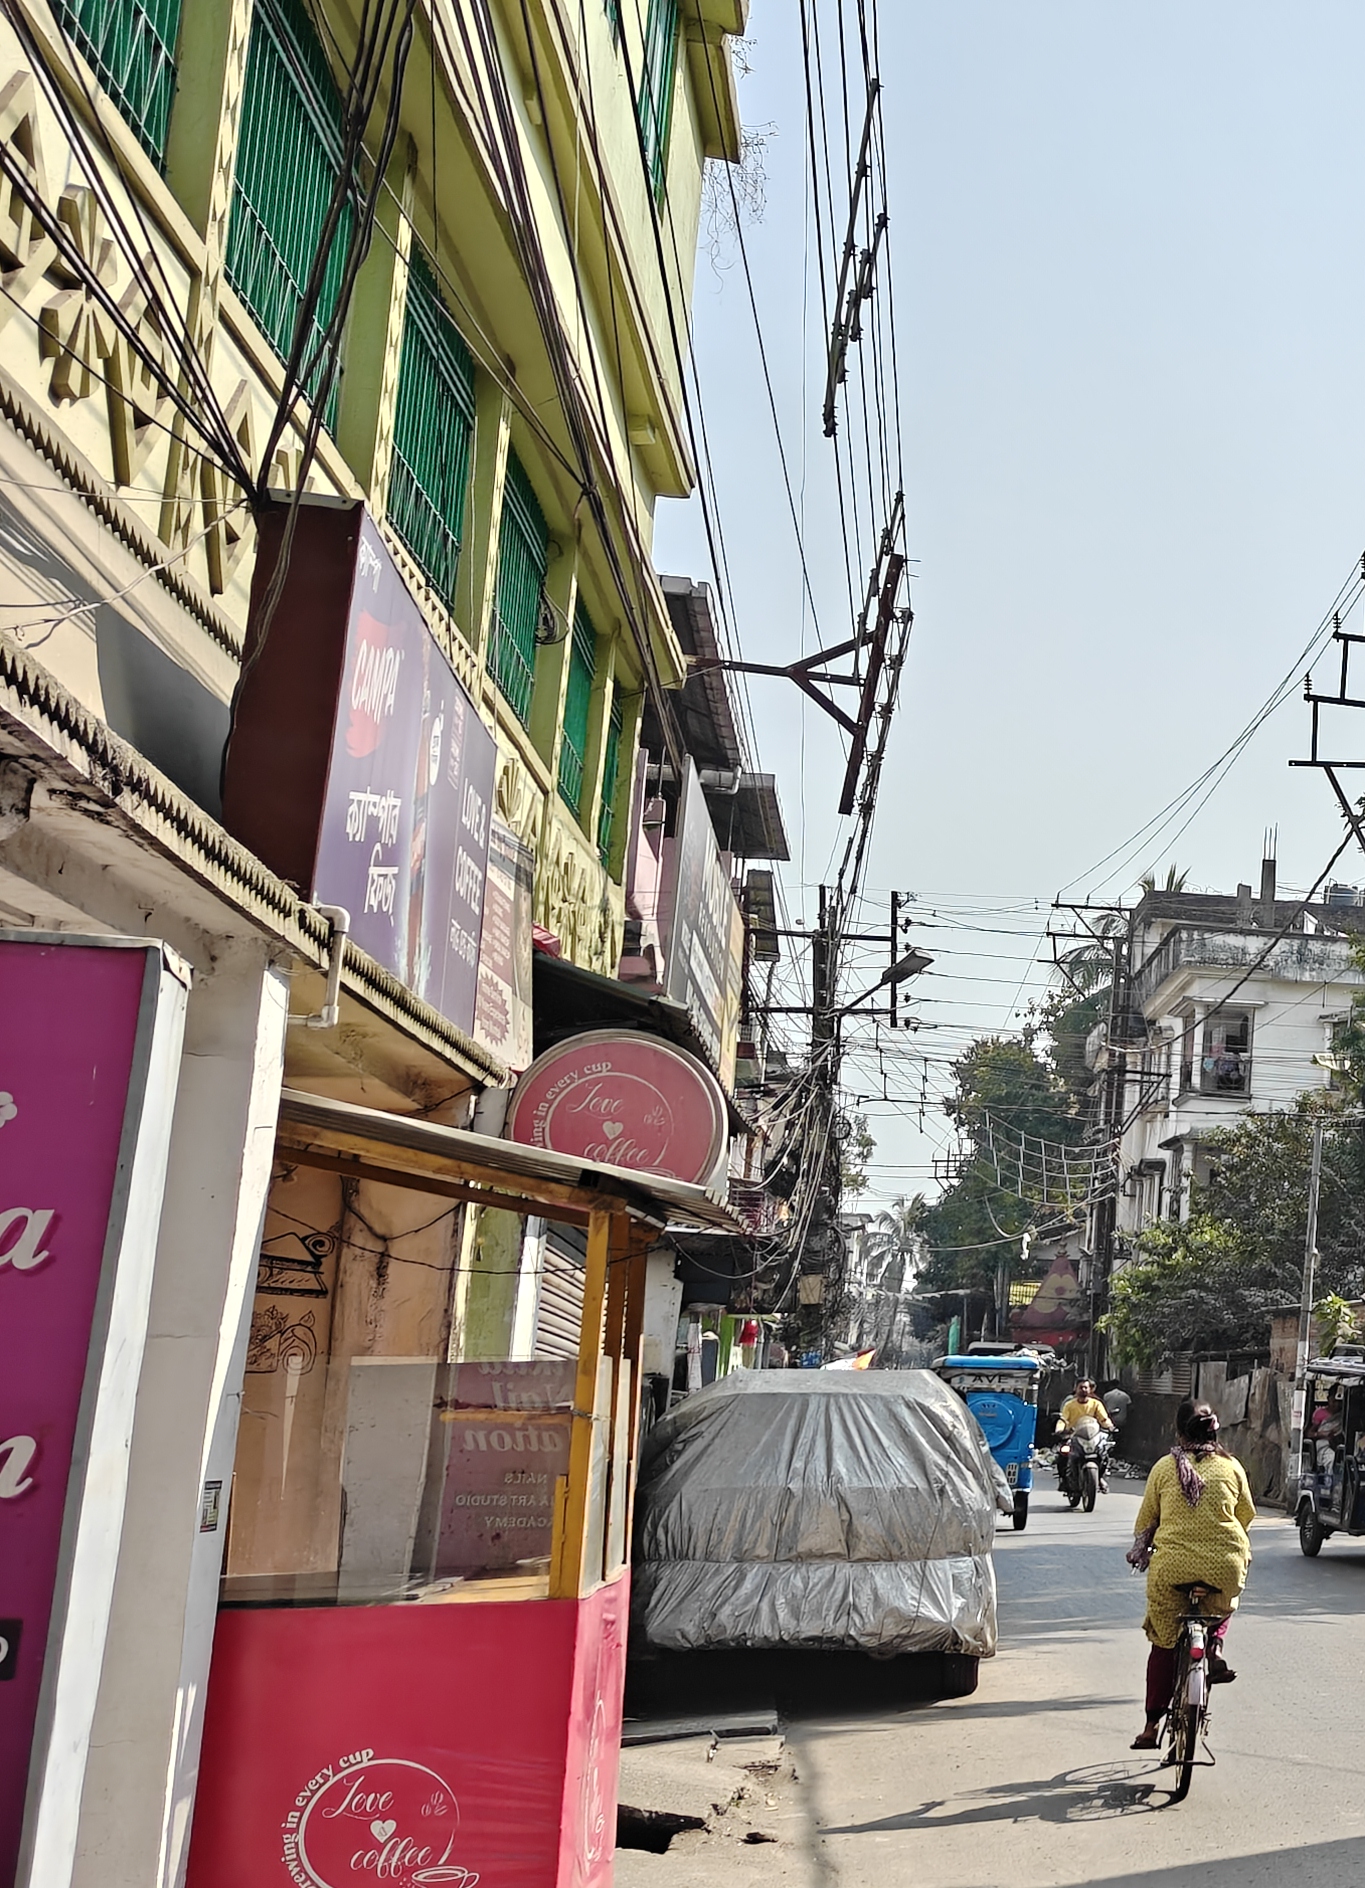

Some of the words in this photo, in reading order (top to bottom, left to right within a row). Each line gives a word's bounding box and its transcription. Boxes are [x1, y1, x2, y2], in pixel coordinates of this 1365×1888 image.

[351, 639, 400, 724] CAMPA
[461, 778, 481, 842] LOVE
[454, 845, 483, 916] COFFEE
[533, 1102, 549, 1120] in
[546, 1069, 579, 1100] every
[583, 1061, 612, 1078] cup
[566, 1082, 625, 1119] Love
[584, 1137, 652, 1166] coffee
[281, 1810, 301, 1829] in
[294, 1764, 335, 1807] every
[338, 1748, 375, 1768] cup
[322, 1776, 395, 1820] Love
[350, 1837, 432, 1879] coffee
